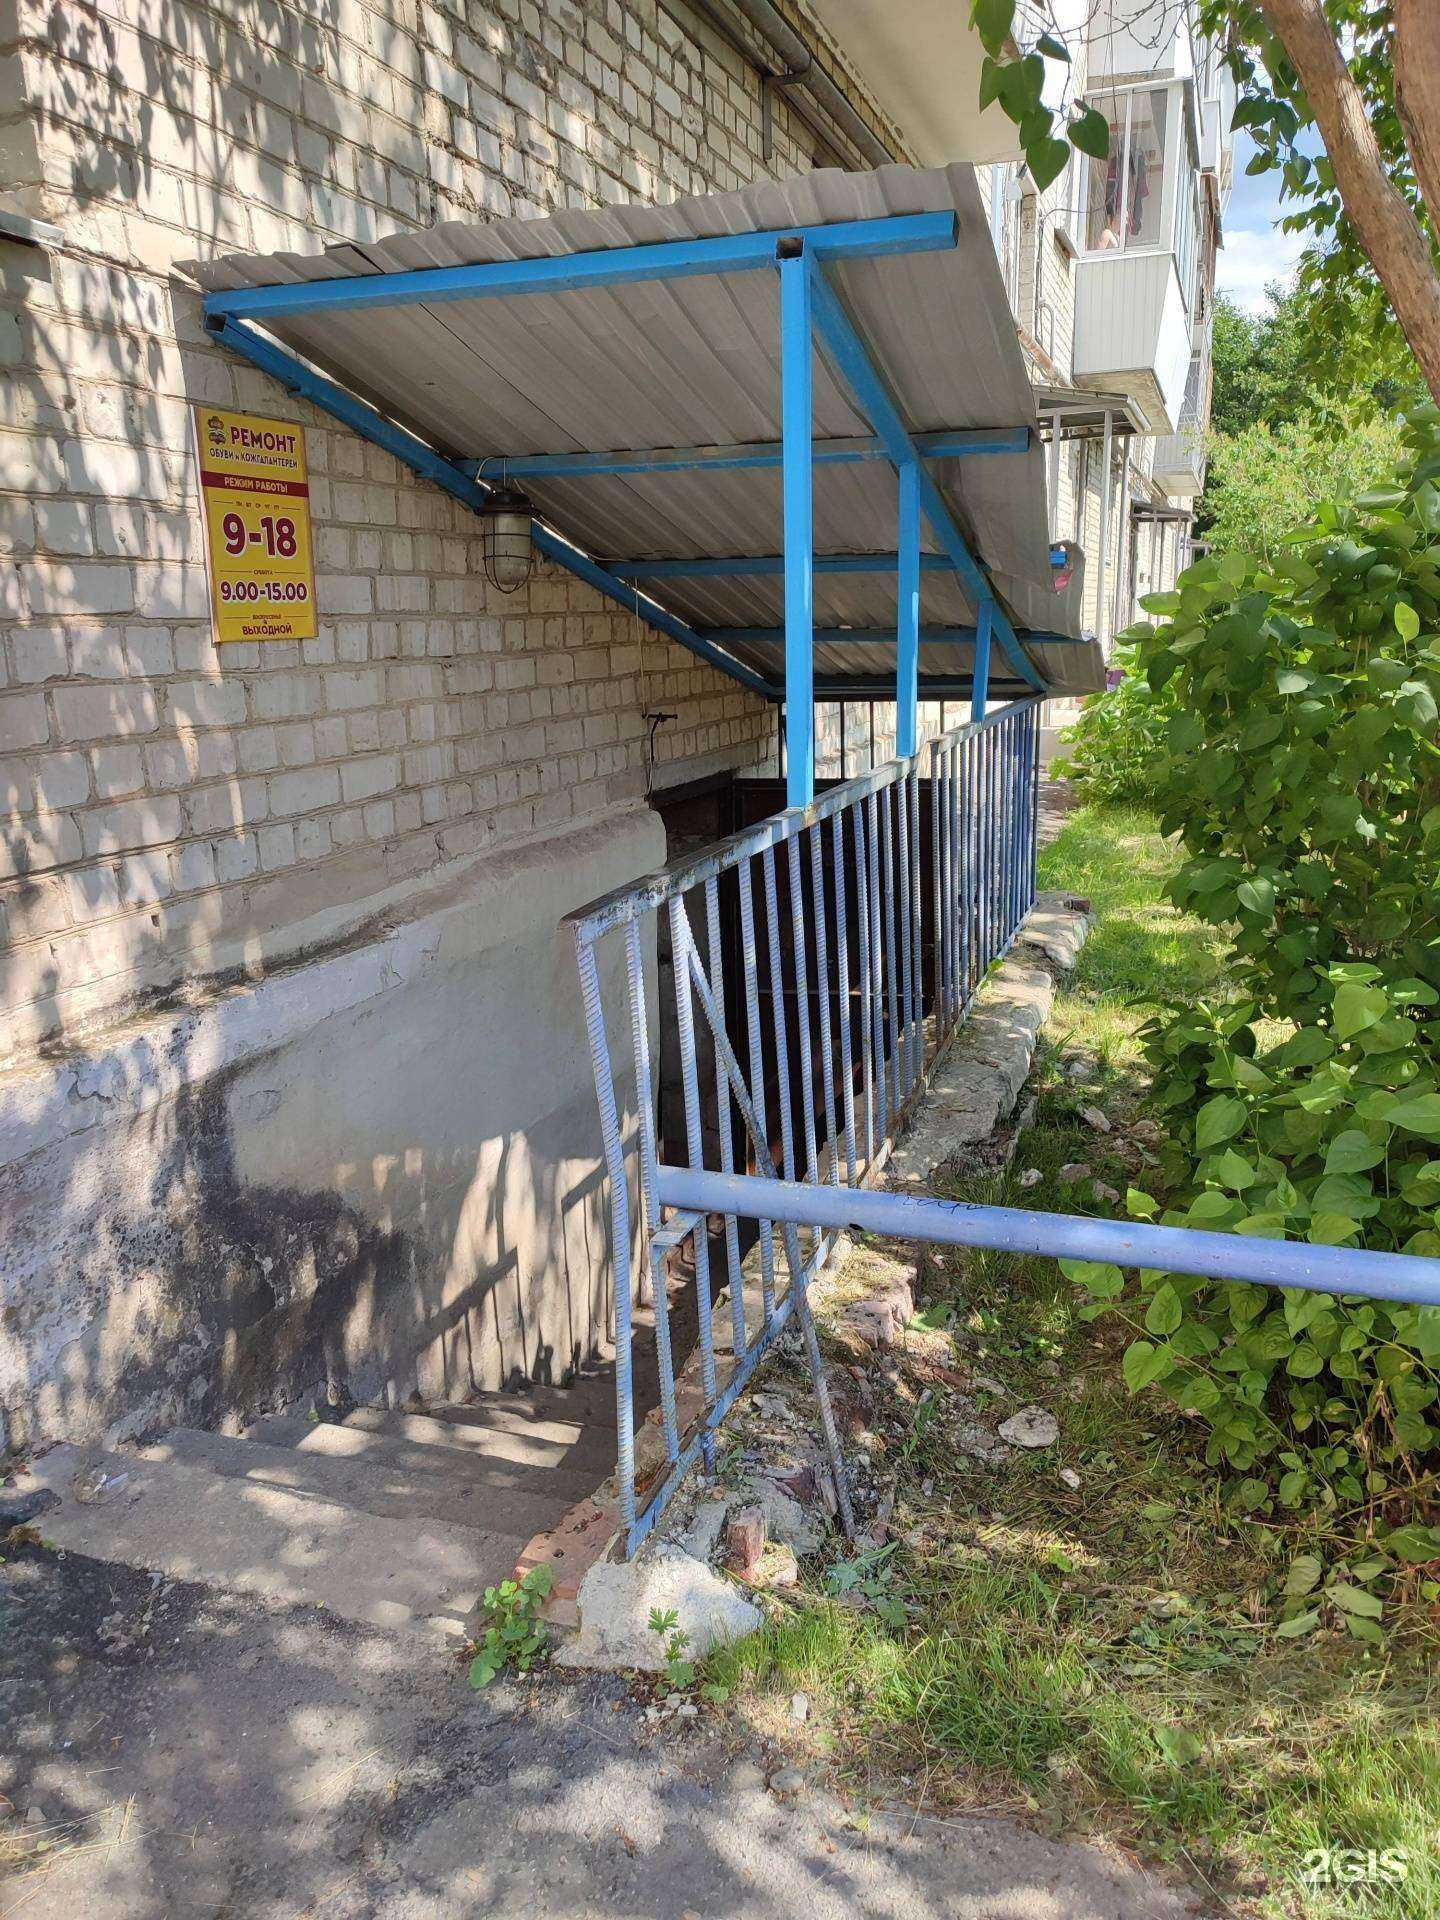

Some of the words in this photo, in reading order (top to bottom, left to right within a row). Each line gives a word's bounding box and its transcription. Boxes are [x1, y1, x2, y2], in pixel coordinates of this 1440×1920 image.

[230, 426, 296, 453] РЕМОНТ
[209, 448, 234, 459] ОБУВИ
[224, 477, 254, 489] РЕЖИМ
[255, 480, 288, 493] РАБОТЫ
[222, 512, 297, 557] 9-18
[220, 581, 308, 601] 9.00-15.00
[242, 623, 292, 636] ВЫХОДНОЙ
